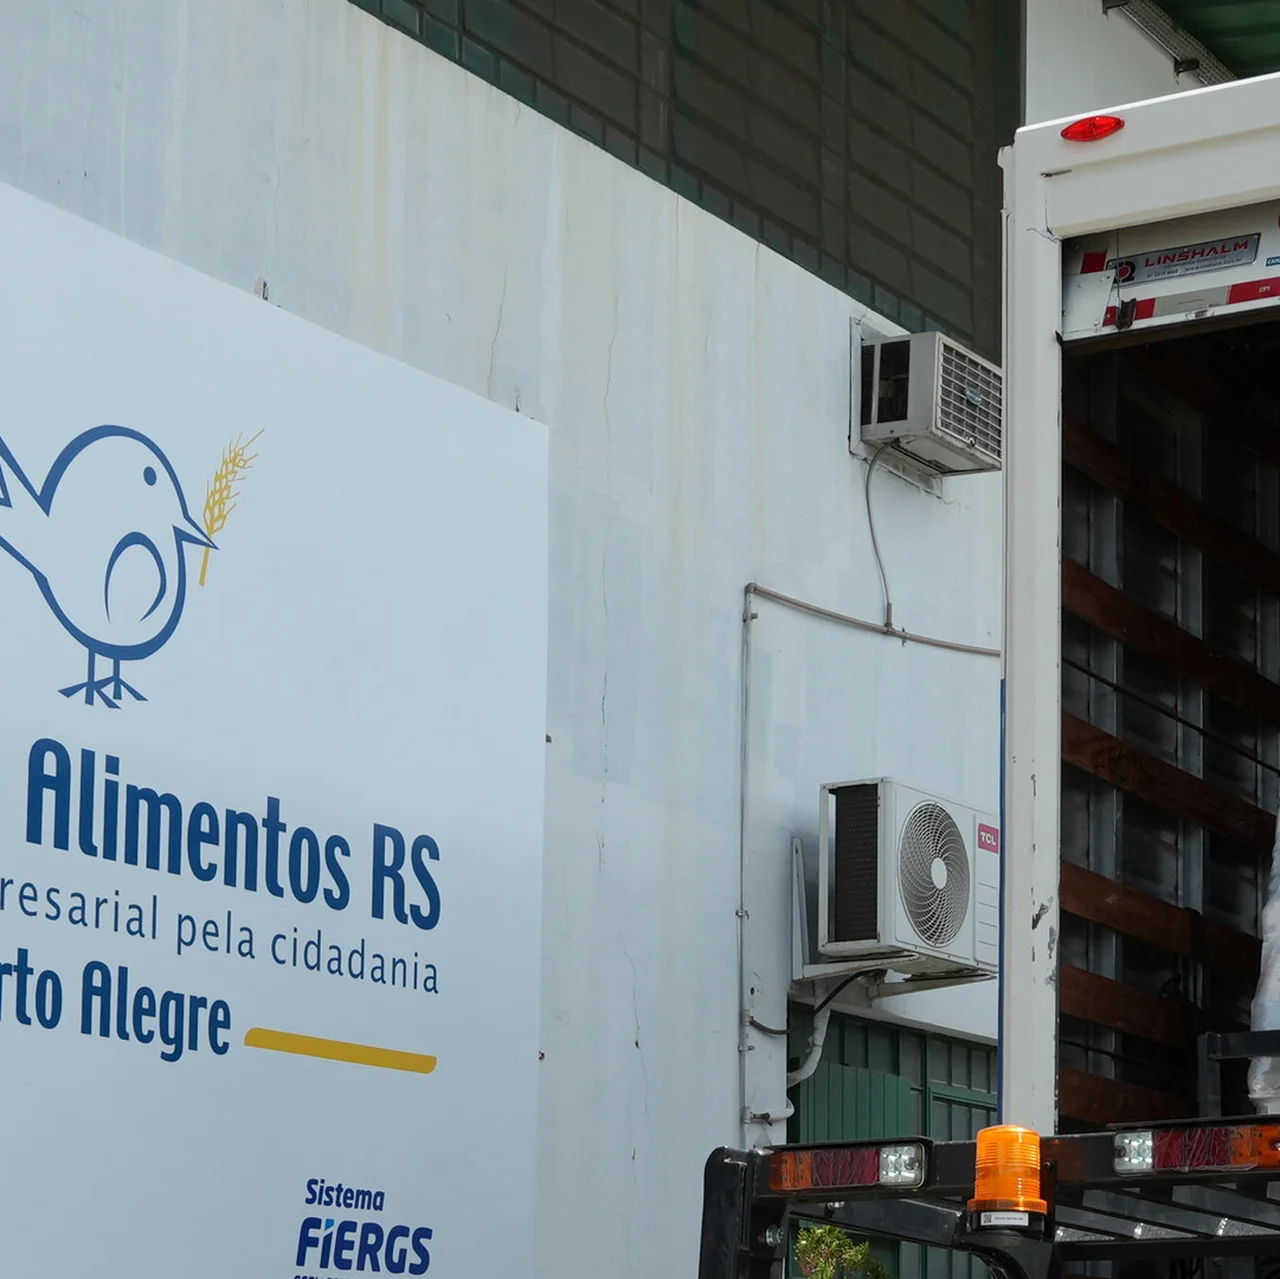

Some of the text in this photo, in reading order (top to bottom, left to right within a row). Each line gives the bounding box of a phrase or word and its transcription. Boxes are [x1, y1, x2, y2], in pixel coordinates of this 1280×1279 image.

[1144, 240, 1249, 268] LINSHALM
[25, 738, 351, 911] Alimentos
[371, 823, 441, 931] RS
[980, 831, 997, 846] TCL
[176, 910, 256, 960] pela
[271, 929, 439, 995] cidadania
[80, 960, 231, 1063] Alegre
[304, 1178, 385, 1212] Sistema
